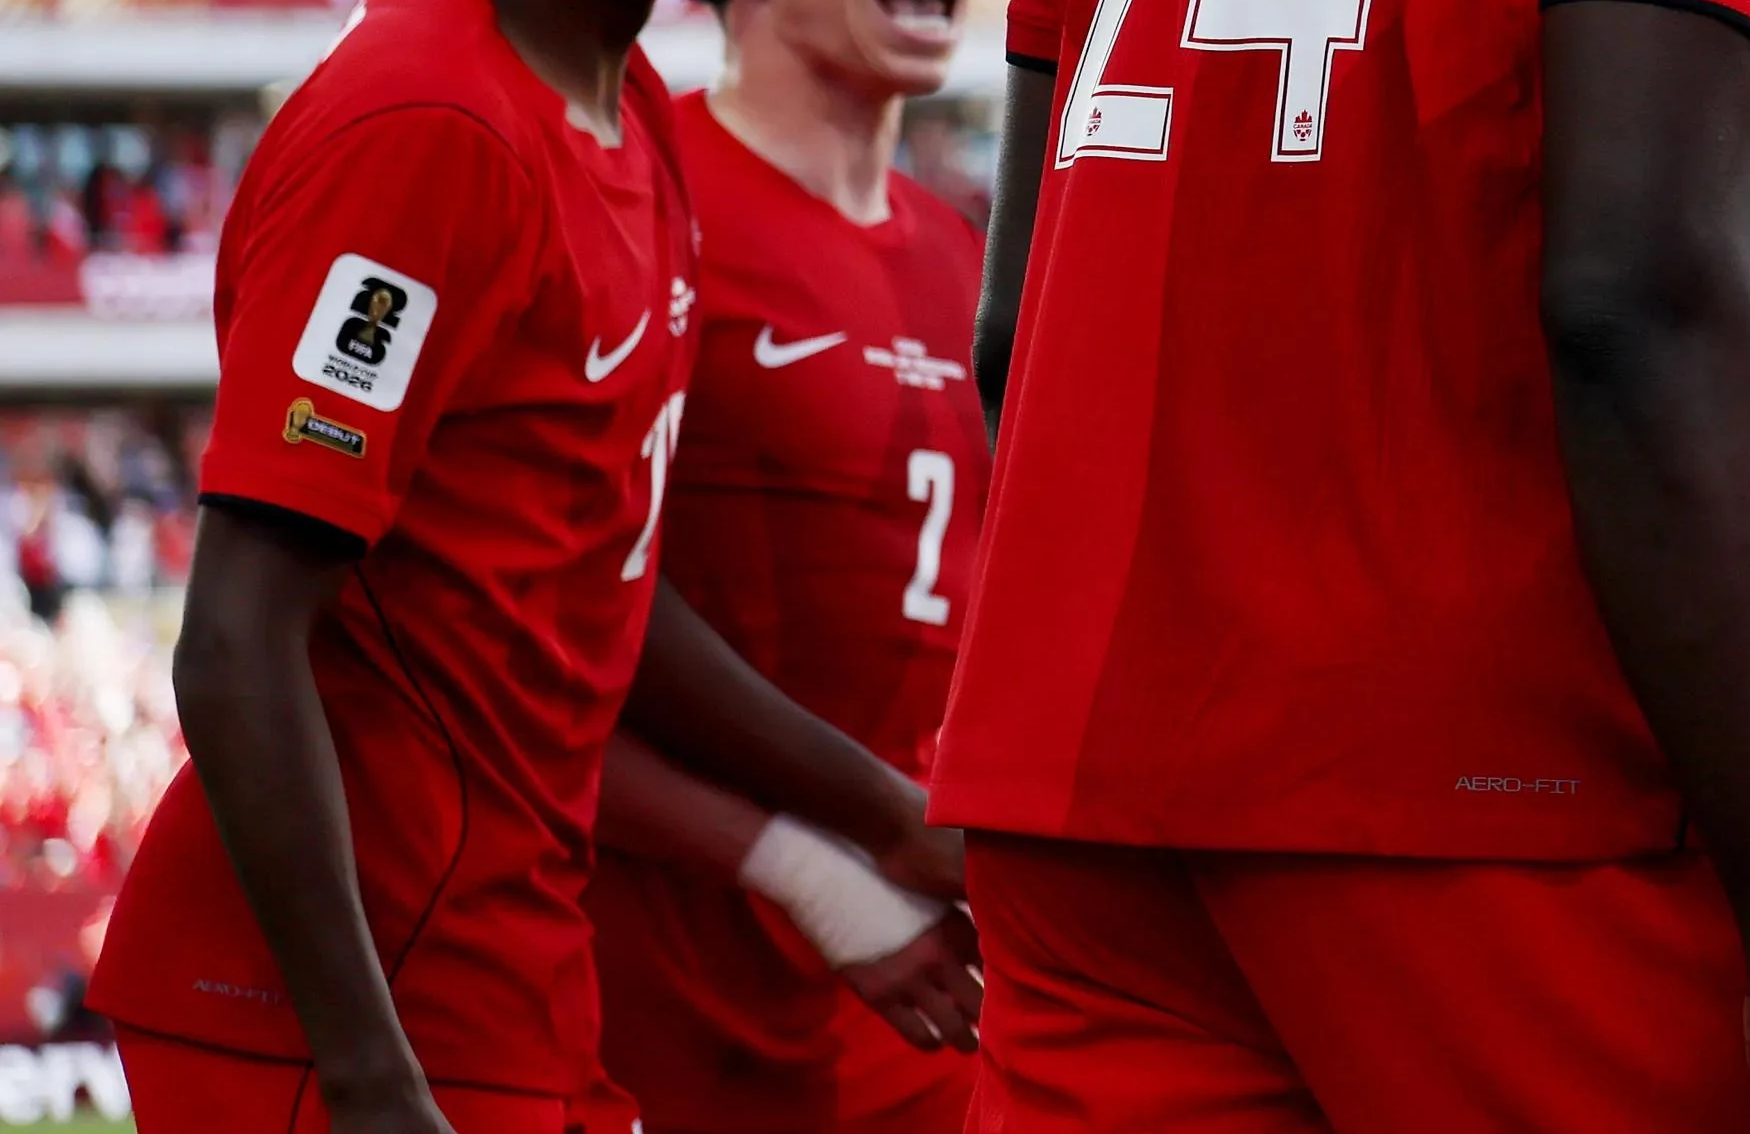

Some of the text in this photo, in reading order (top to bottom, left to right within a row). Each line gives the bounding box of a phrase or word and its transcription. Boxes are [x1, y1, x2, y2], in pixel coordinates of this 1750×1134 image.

[323, 364, 373, 392] 2026
[308, 418, 361, 445] DEBUT
[902, 449, 954, 626] 2
[1455, 776, 1581, 795] AERO-FIT
